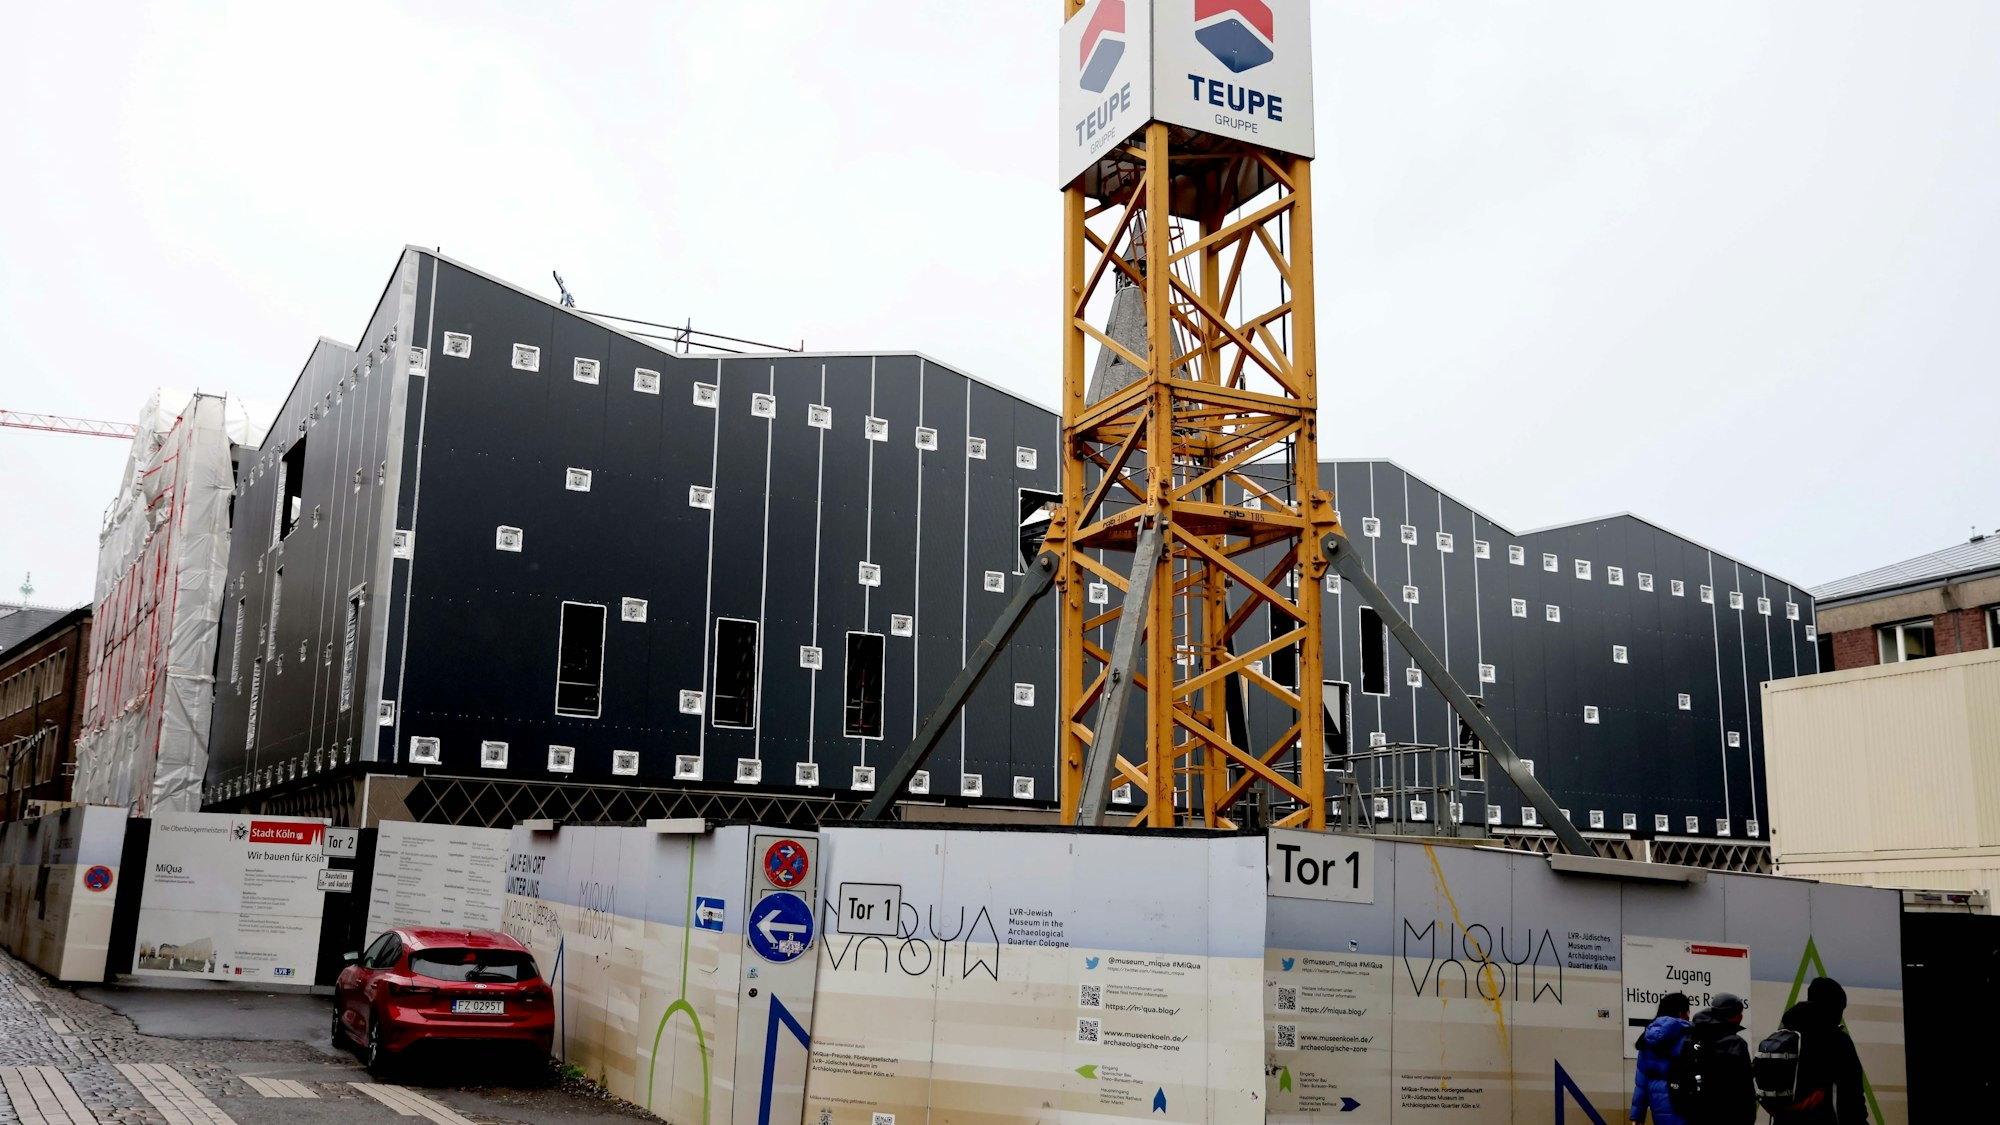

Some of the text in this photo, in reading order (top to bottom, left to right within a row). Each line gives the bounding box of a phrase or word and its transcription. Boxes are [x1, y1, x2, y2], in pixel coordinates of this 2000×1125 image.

[1188, 73, 1282, 122] TEUPE
[1075, 82, 1130, 147] TEUPE
[1215, 114, 1258, 134] GRUPPE
[1090, 127, 1116, 155] GRUPPE
[171, 825, 228, 834] Oberbürgermeisterin
[252, 828, 296, 839] Stadt Köln
[328, 836, 354, 849] Tor 2
[248, 851, 324, 863] Wir bauen für Köln
[155, 864, 182, 874] MiQua
[533, 856, 546, 875] ORT
[1276, 843, 1359, 889] Tor 1
[325, 872, 348, 880] Baustellen
[508, 876, 527, 896] UNTER
[849, 897, 891, 921] Tor 1
[1009, 908, 1053, 917] LVR-Jewish
[1008, 918, 1064, 928] Museum in the
[1008, 928, 1064, 939] Archaeological
[1568, 932, 1610, 942] LVR-Jüdisches
[1008, 937, 1069, 949] Quarter Cologne
[1568, 942, 1593, 950] Museum
[1568, 952, 1616, 962] Archäologischen
[1108, 956, 1201, 970] @museum_miqua #MiQua
[1302, 957, 1383, 969] @museum_miqua #MiQua
[1568, 961, 1593, 969] Quartier
[1666, 965, 1711, 986] Zugang
[458, 1001, 502, 1011] FZ 0295T
[1301, 1006, 1367, 1017] https://miqua.blog/
[1104, 1030, 1188, 1042] www.museenkoeln.de/
[1301, 1035, 1374, 1043] www.museenkoeln.de/
[1103, 1039, 1180, 1051] archaeologische-zone
[1301, 1044, 1368, 1053] archaeologische-zone
[812, 1058, 848, 1066] LVR-Jüdisches
[812, 1065, 852, 1074] Archäologischen
